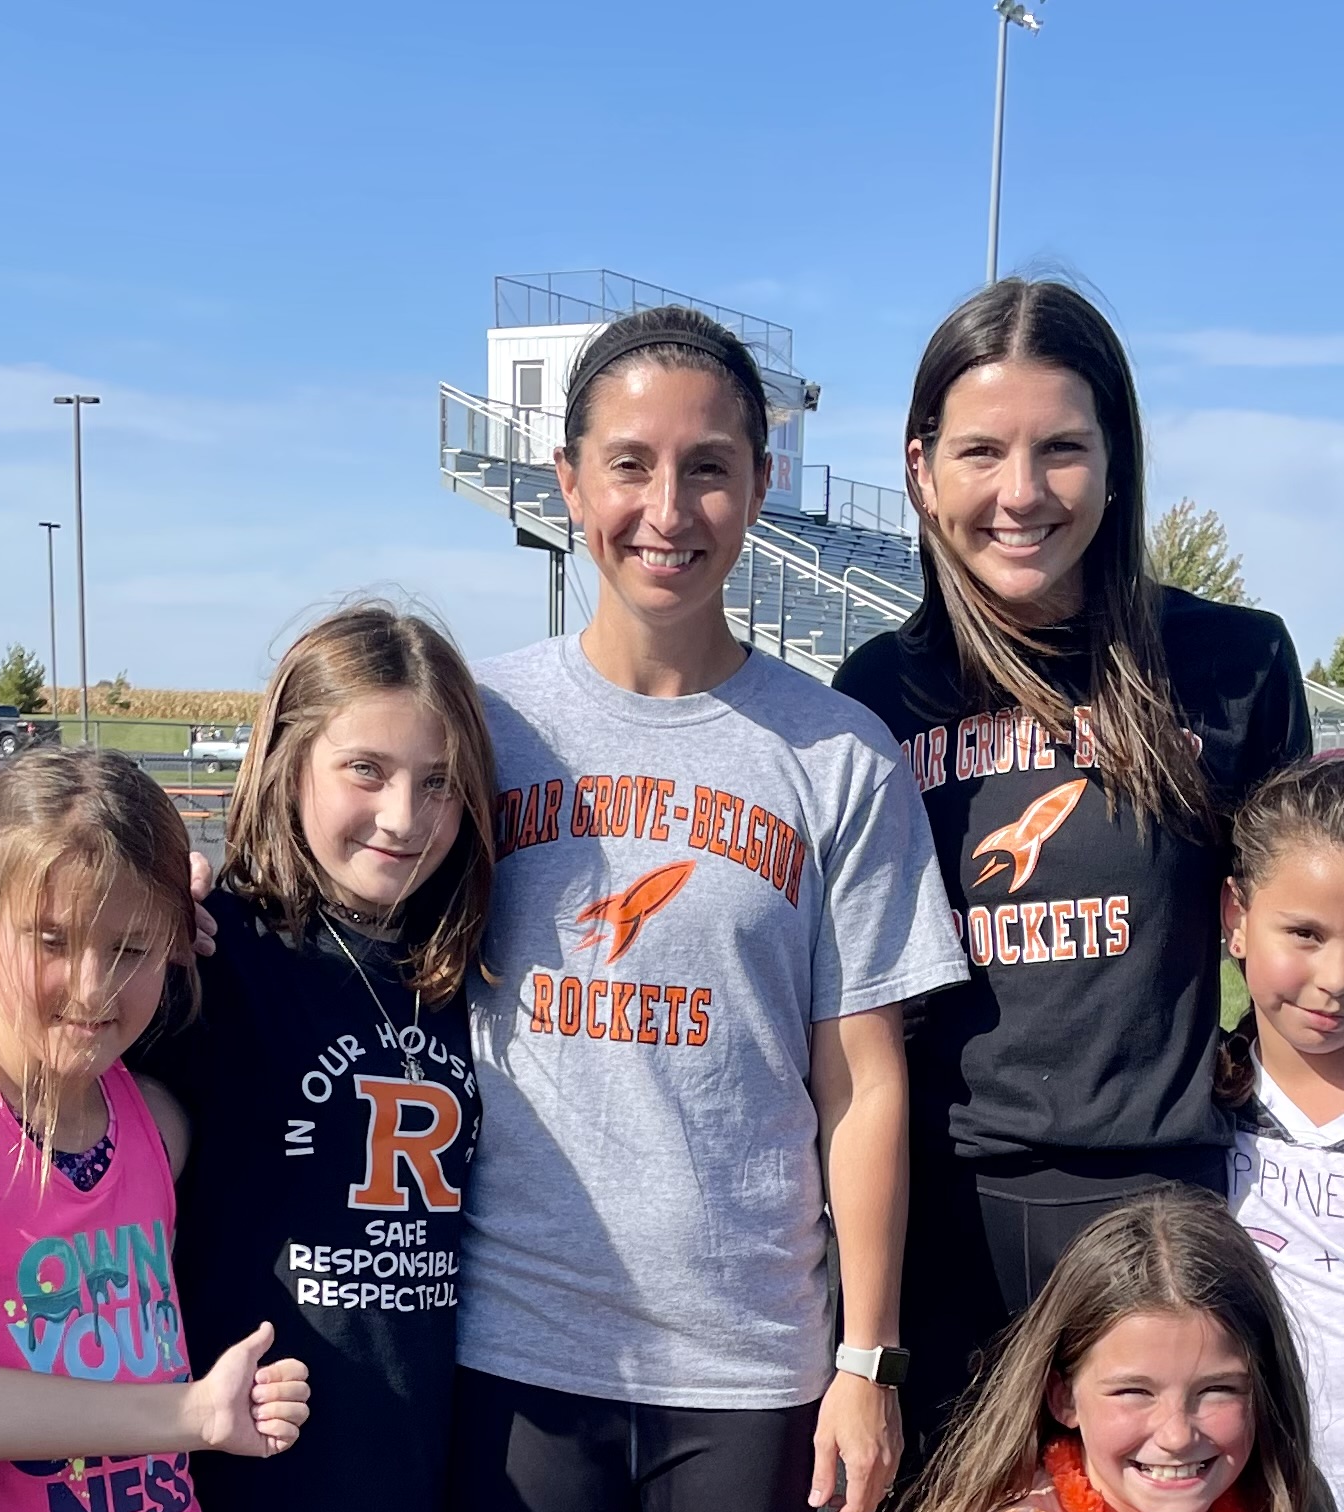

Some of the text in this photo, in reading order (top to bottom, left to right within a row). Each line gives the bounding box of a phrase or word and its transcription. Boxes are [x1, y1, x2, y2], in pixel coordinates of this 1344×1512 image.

[529, 973, 712, 1047] ROCKETS
[284, 1119, 316, 1156] IN
[302, 1034, 367, 1103] OUR
[347, 1073, 462, 1212] R
[17, 1219, 170, 1318] OWN
[364, 1219, 428, 1248] SAFE
[296, 1277, 459, 1312] RESPECTFUL
[8, 1300, 186, 1382] YOUR
